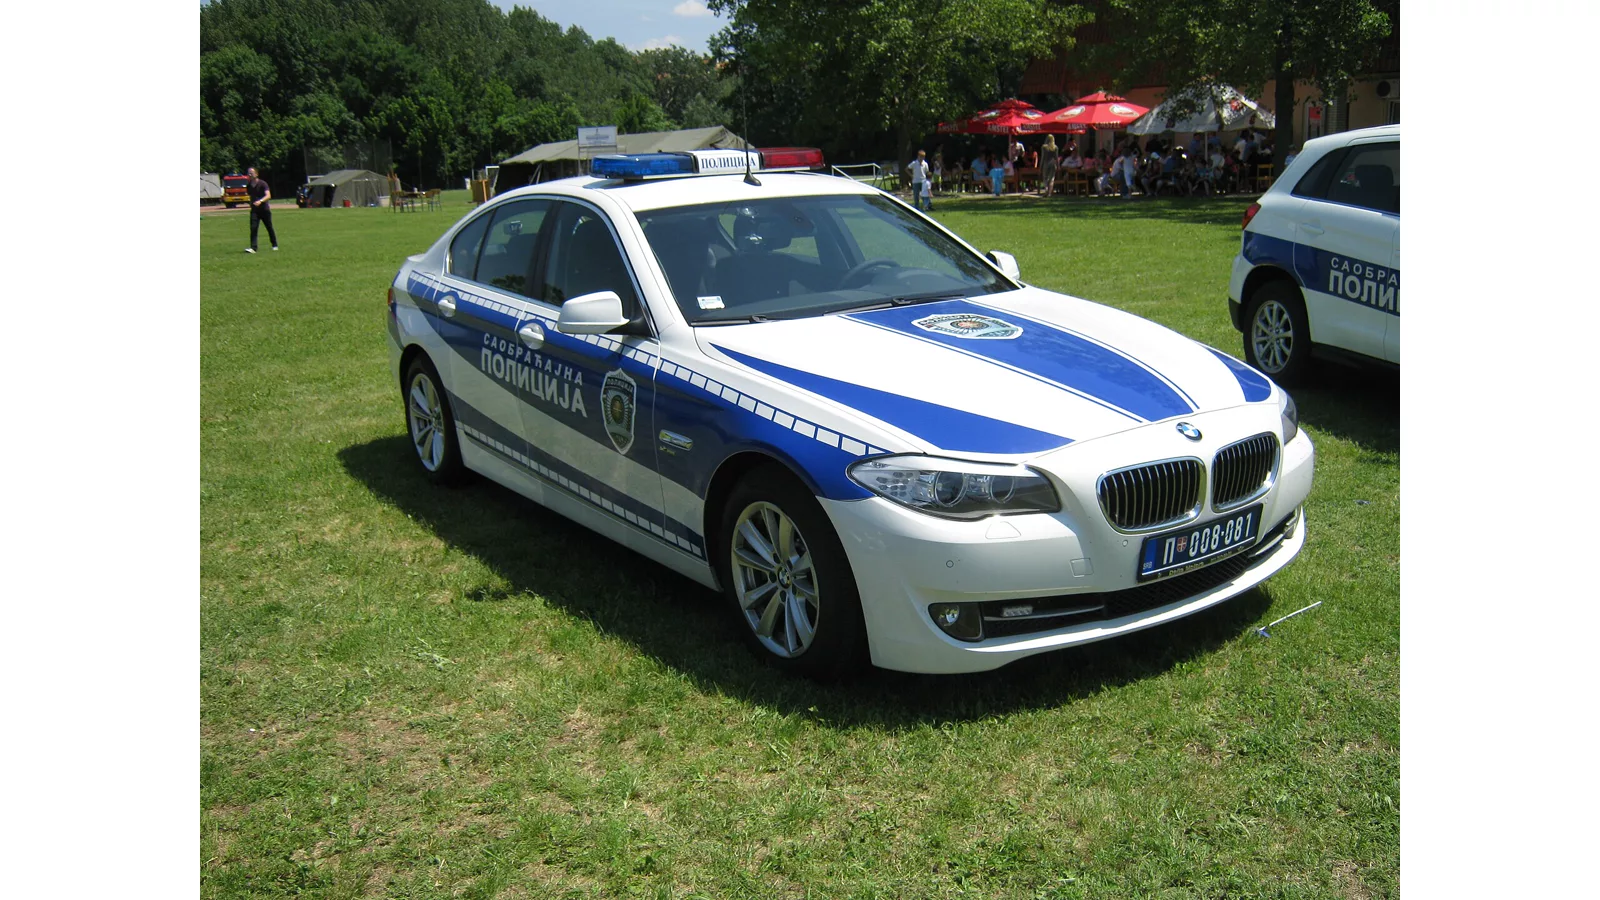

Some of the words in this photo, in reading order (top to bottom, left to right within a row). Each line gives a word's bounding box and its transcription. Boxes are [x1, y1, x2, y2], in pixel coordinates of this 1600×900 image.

[985, 124, 1009, 133] AMSTEL
[1329, 269, 1400, 313] ПОЛИ
[481, 347, 588, 418] ПОЛИЦИЈА
[483, 333, 583, 386] САОБРАЋАЈНА
